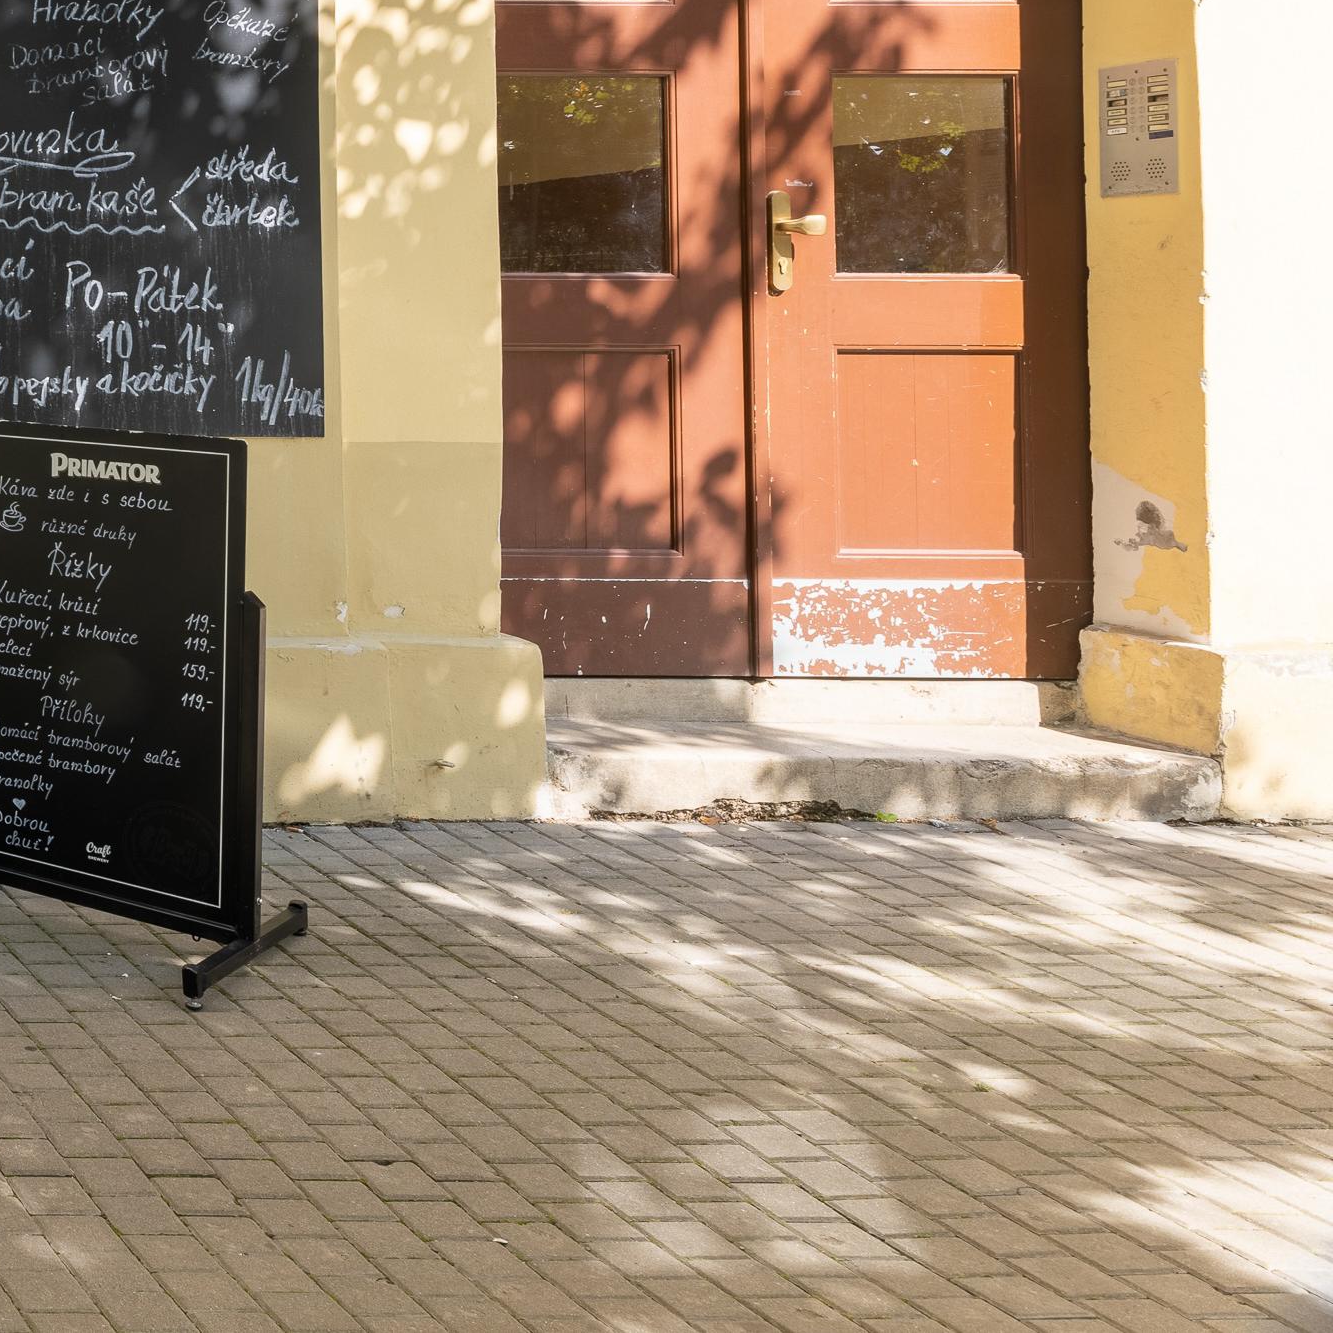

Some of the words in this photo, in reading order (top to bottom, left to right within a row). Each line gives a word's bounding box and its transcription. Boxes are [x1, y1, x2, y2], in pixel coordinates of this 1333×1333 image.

[87, 177, 158, 214] kaše
[48, 486, 75, 502] zde
[83, 488, 90, 504] i
[101, 492, 110, 506] s
[120, 491, 174, 512] sebou
[41, 518, 88, 537] různé
[93, 524, 137, 549] druhy
[47, 541, 112, 594] Řízky
[58, 591, 102, 617] krůtí
[62, 623, 71, 638] z
[76, 623, 141, 646] krkovice
[58, 670, 81, 691] sýr
[40, 695, 105, 737] Přílohy
[48, 730, 135, 762] bramborový
[143, 749, 181, 768] salát
[49, 753, 116, 784] brambory
[86, 842, 112, 857] Craft
